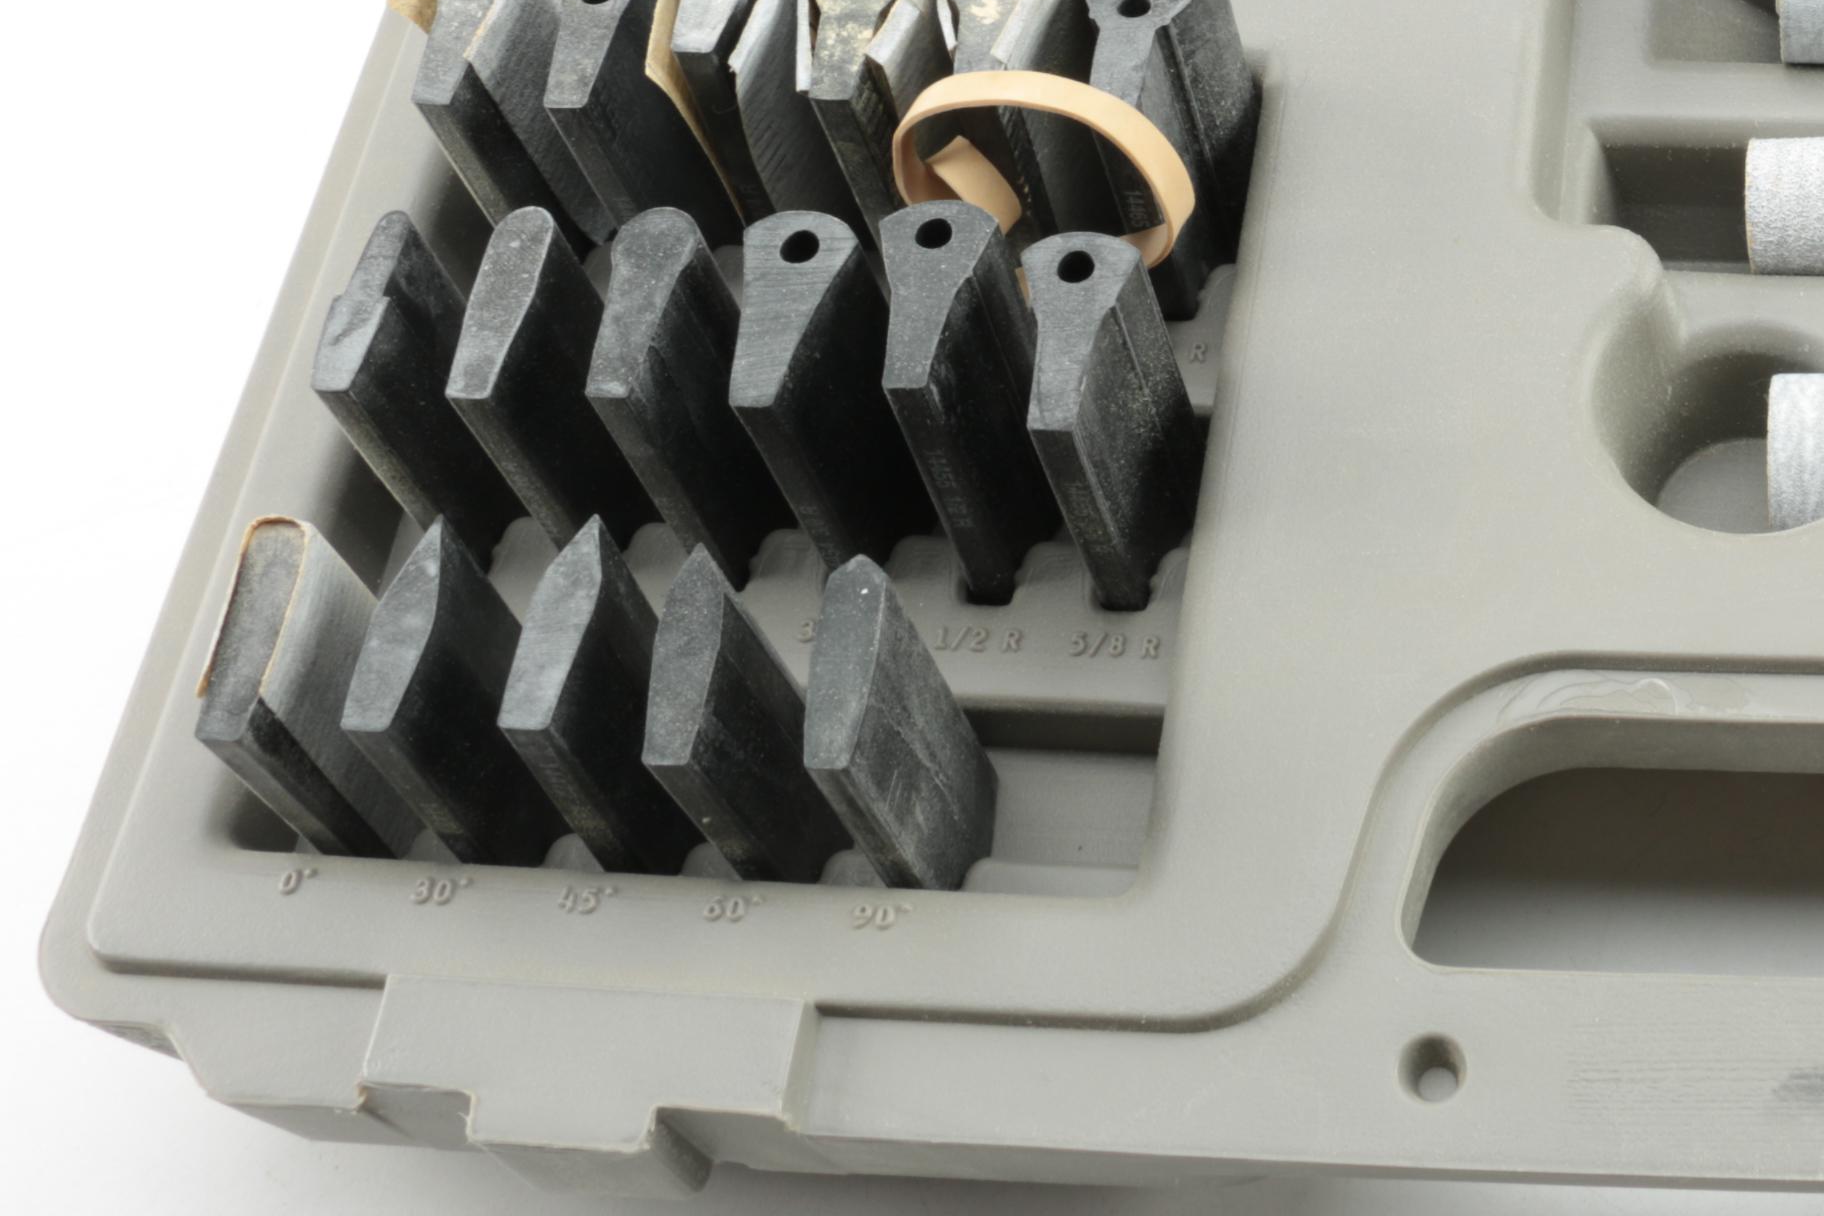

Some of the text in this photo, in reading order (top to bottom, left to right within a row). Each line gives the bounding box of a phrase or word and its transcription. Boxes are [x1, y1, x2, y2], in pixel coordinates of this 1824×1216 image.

[934, 627, 1022, 653] 1/2 R
[1069, 632, 1161, 659] 5/8 R
[279, 868, 316, 895] 0°
[410, 877, 472, 904] 30°
[557, 889, 617, 914] 45°
[702, 894, 762, 922] 60°
[851, 900, 912, 930] 90°
